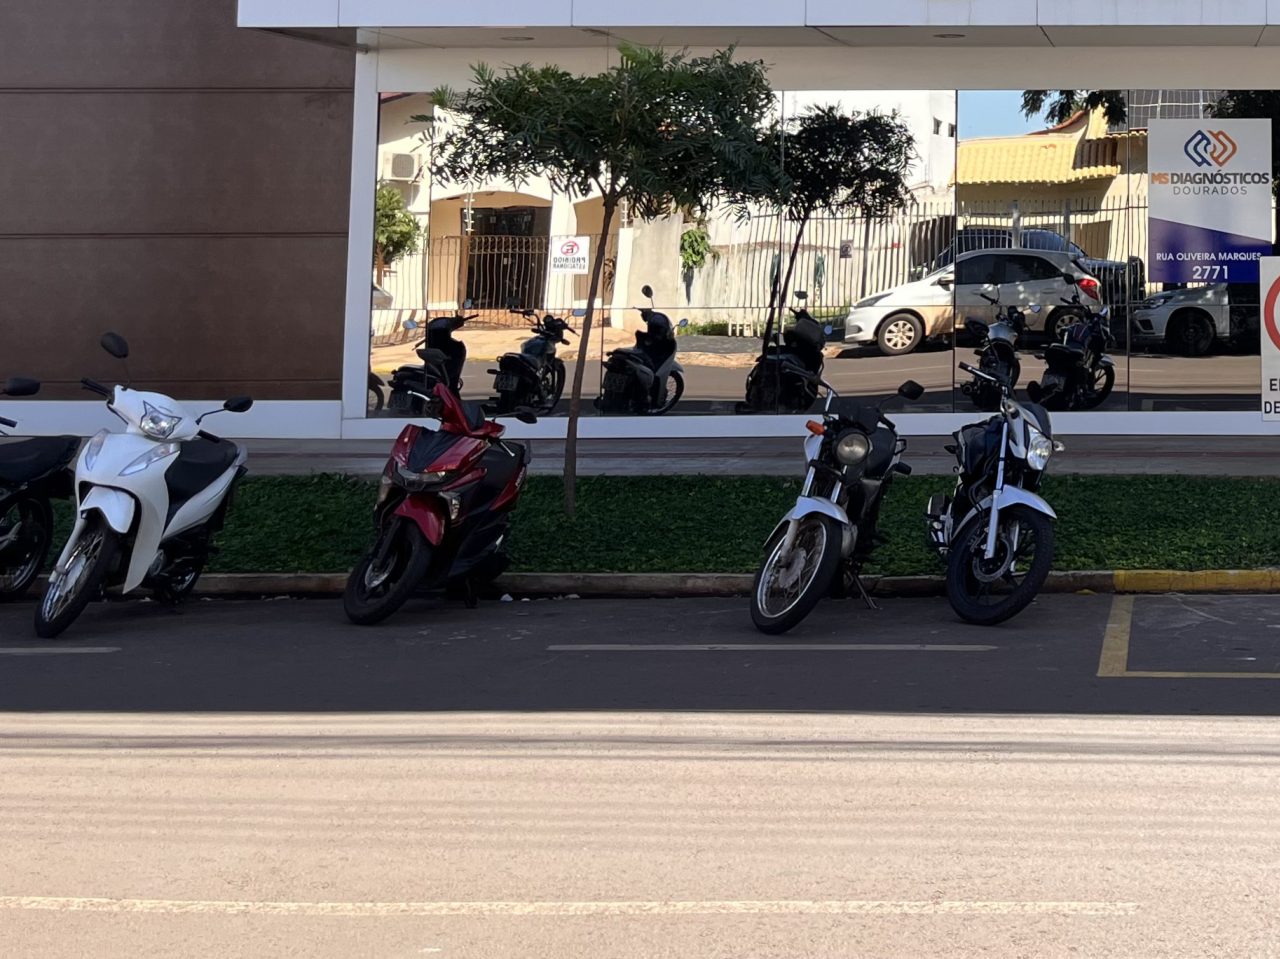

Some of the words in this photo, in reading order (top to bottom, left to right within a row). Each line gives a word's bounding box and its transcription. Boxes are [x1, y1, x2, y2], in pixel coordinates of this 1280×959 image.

[1151, 172, 1169, 185] MS
[1170, 169, 1270, 185] DIAGNÓSTICOS
[1173, 185, 1248, 196] DOURADOS
[1156, 252, 1174, 261] RUA
[1176, 252, 1217, 261] OLIVEIRA
[1218, 252, 1262, 261] MARQUES
[1192, 265, 1229, 280] 2771
